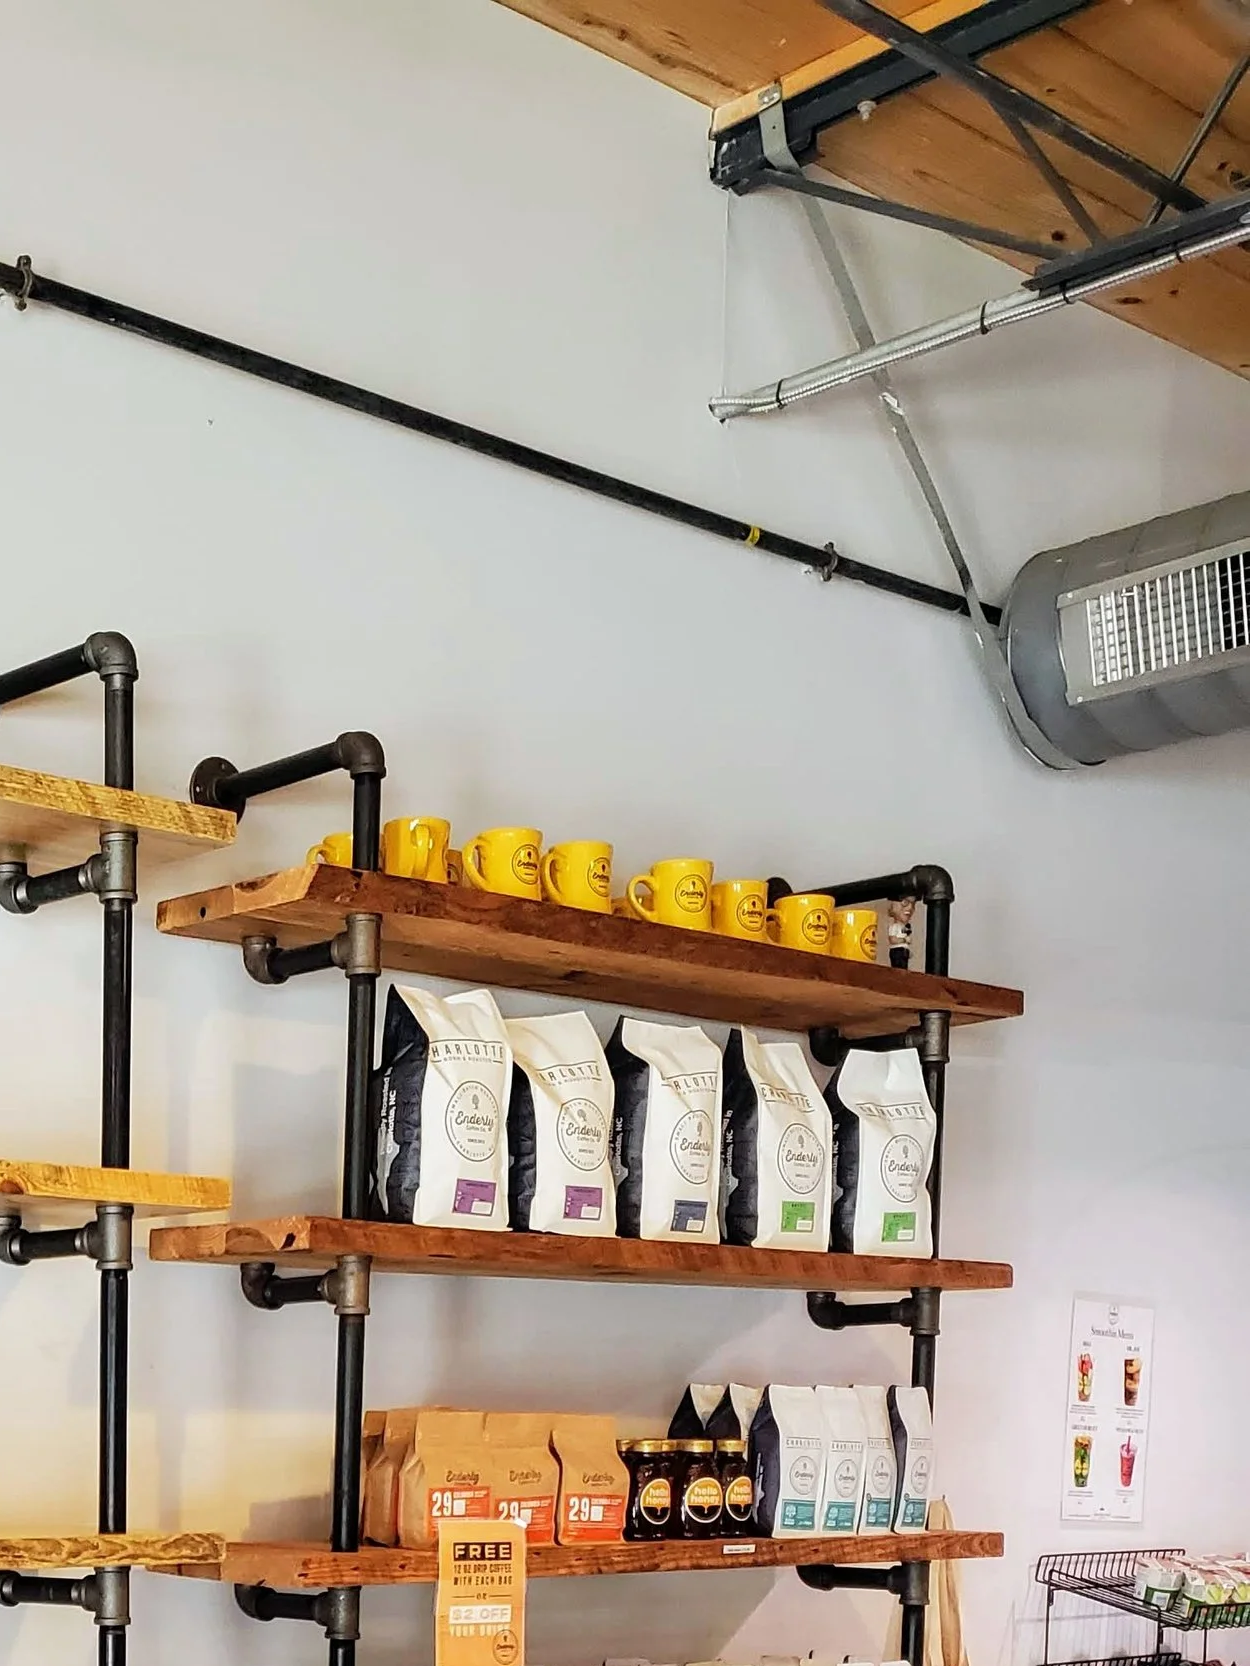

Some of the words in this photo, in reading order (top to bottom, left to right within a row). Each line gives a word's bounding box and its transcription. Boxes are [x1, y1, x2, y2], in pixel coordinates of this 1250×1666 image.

[455, 1110, 494, 1131] Enderly
[565, 1122, 602, 1142] Enderly
[785, 1149, 818, 1169] Enderly
[690, 1495, 720, 1505] honey
[694, 1486, 718, 1496] hello
[432, 1491, 452, 1517] 29
[498, 1501, 520, 1520] 29
[568, 1497, 590, 1521] 29
[454, 1544, 510, 1559] FREE
[479, 1607, 510, 1620] OFF
